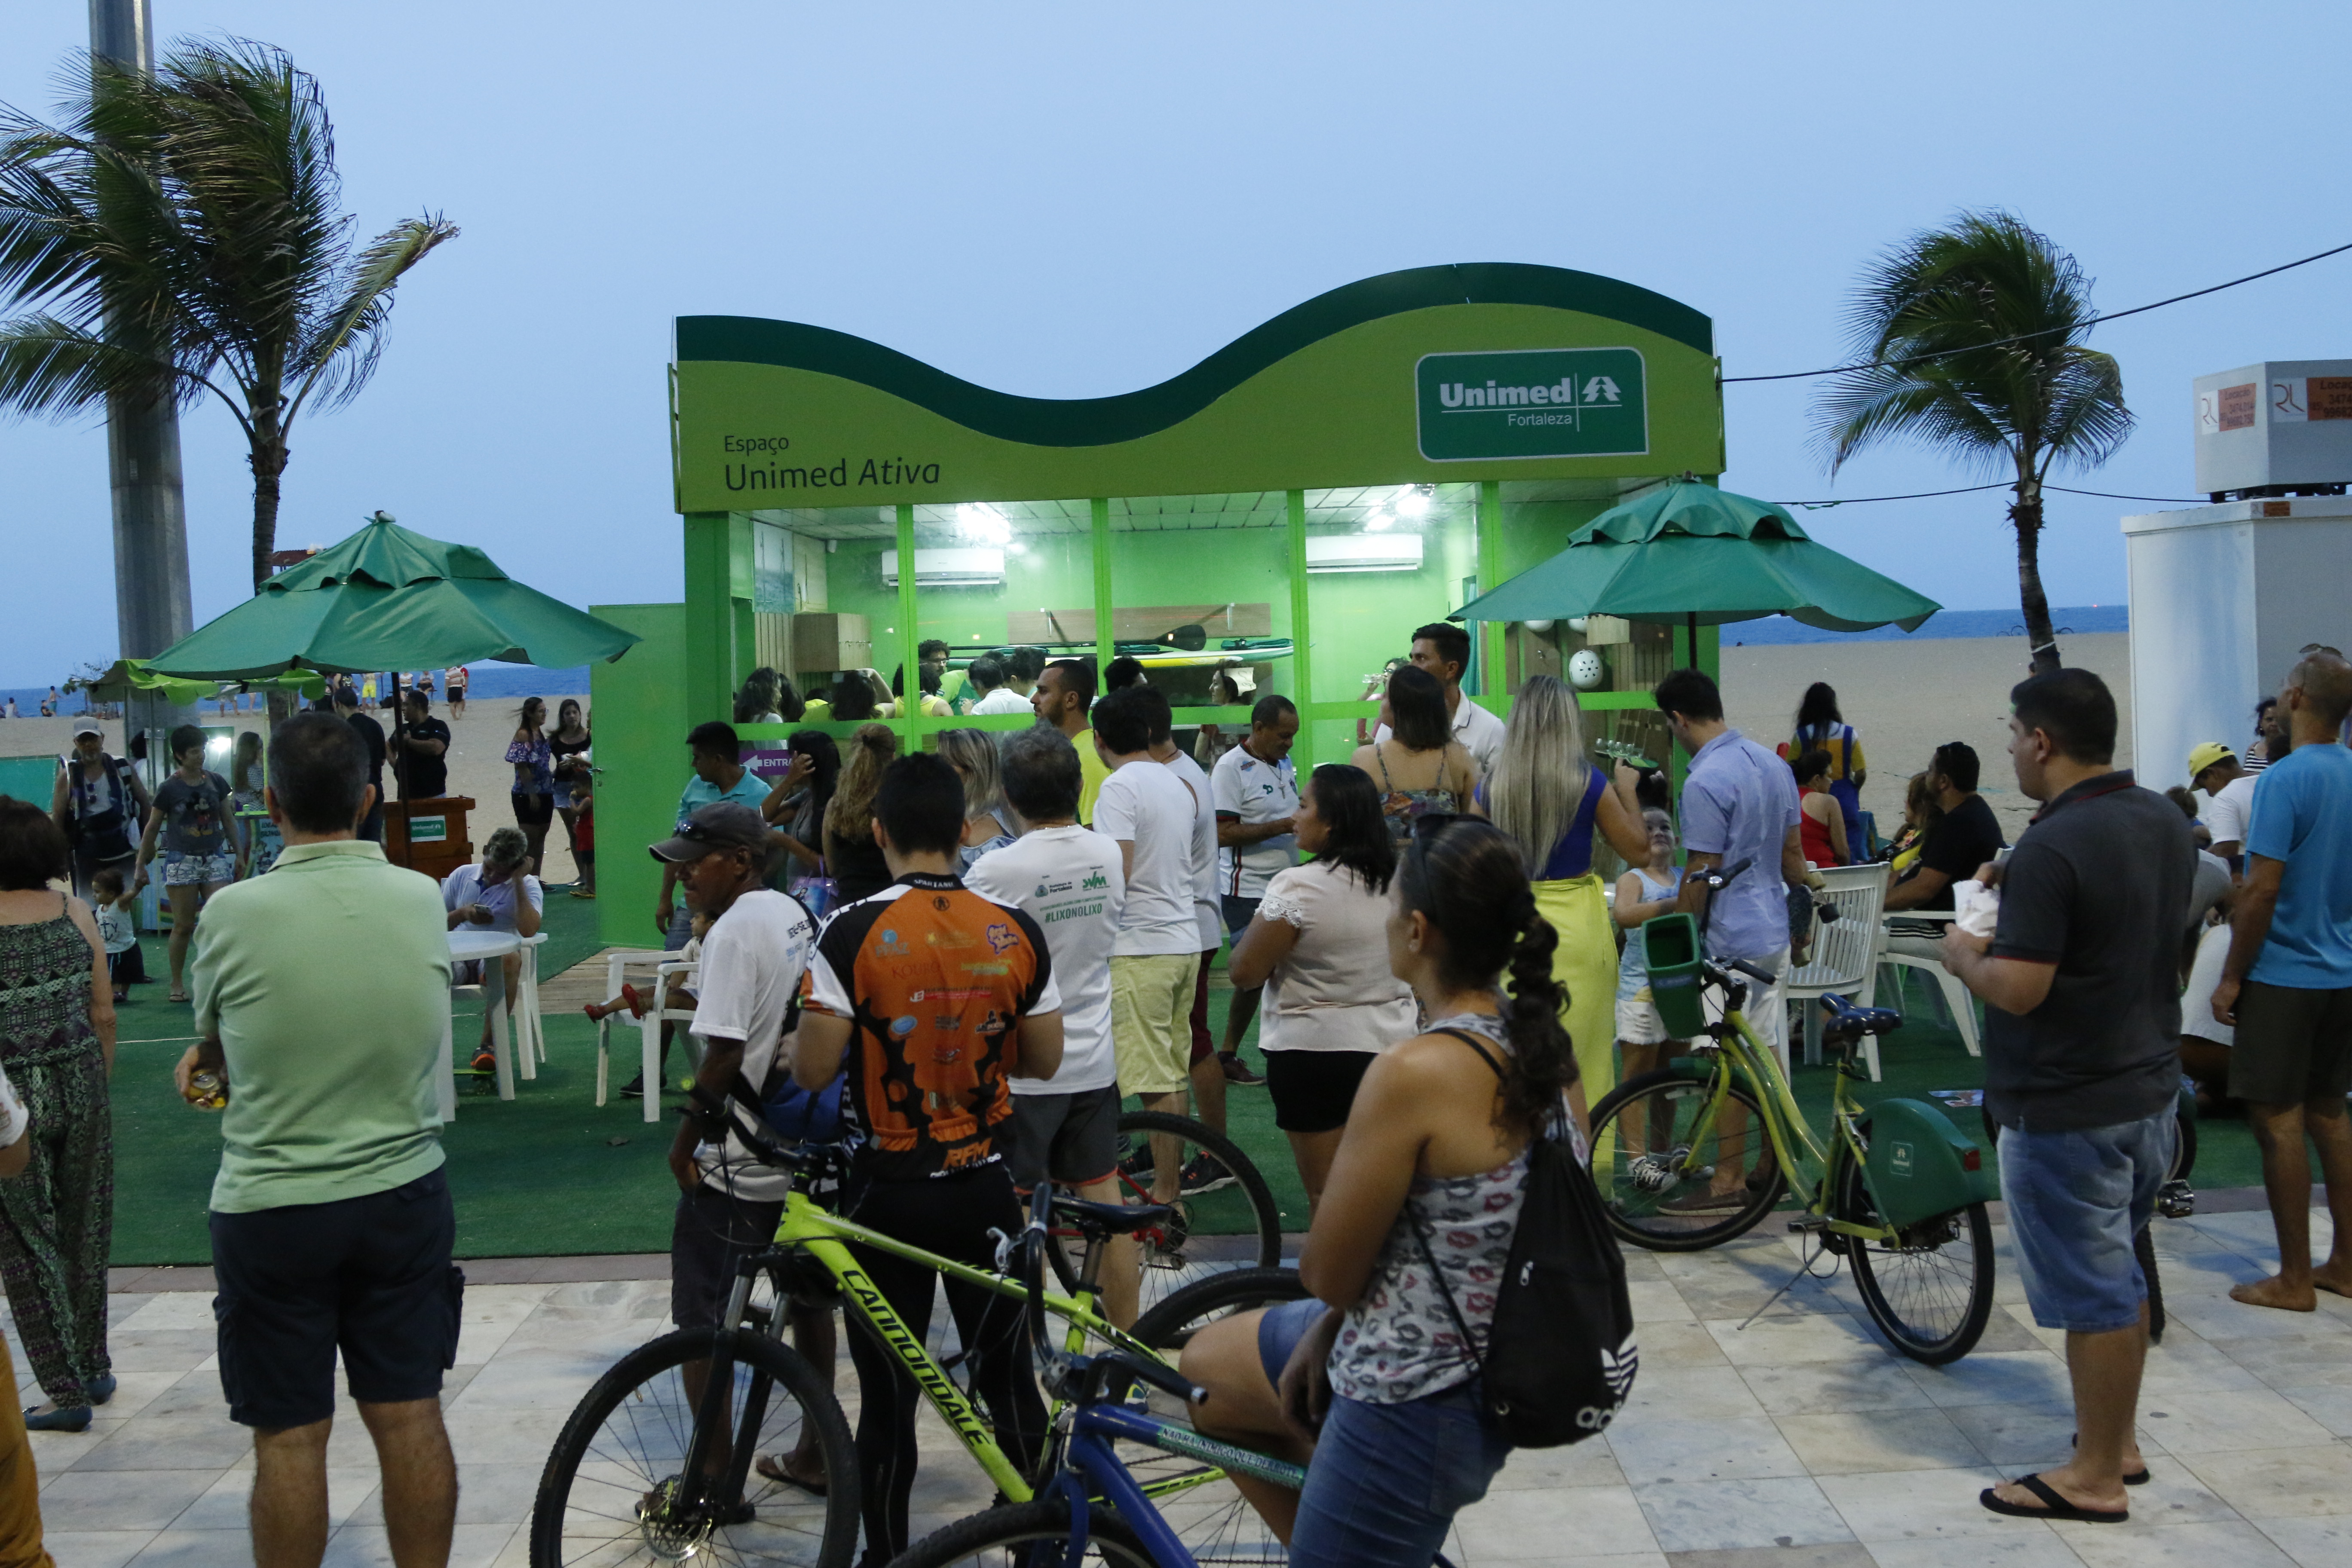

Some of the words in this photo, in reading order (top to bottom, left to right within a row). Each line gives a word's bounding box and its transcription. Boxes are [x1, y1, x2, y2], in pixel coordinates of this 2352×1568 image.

[1440, 377, 1571, 408] Unimed
[1508, 412, 1572, 427] Fortaleza
[724, 435, 790, 456] Espaço
[725, 458, 847, 491] Unimed
[858, 456, 940, 485] Ativa
[1045, 903, 1102, 923] #LIXONOLIXO
